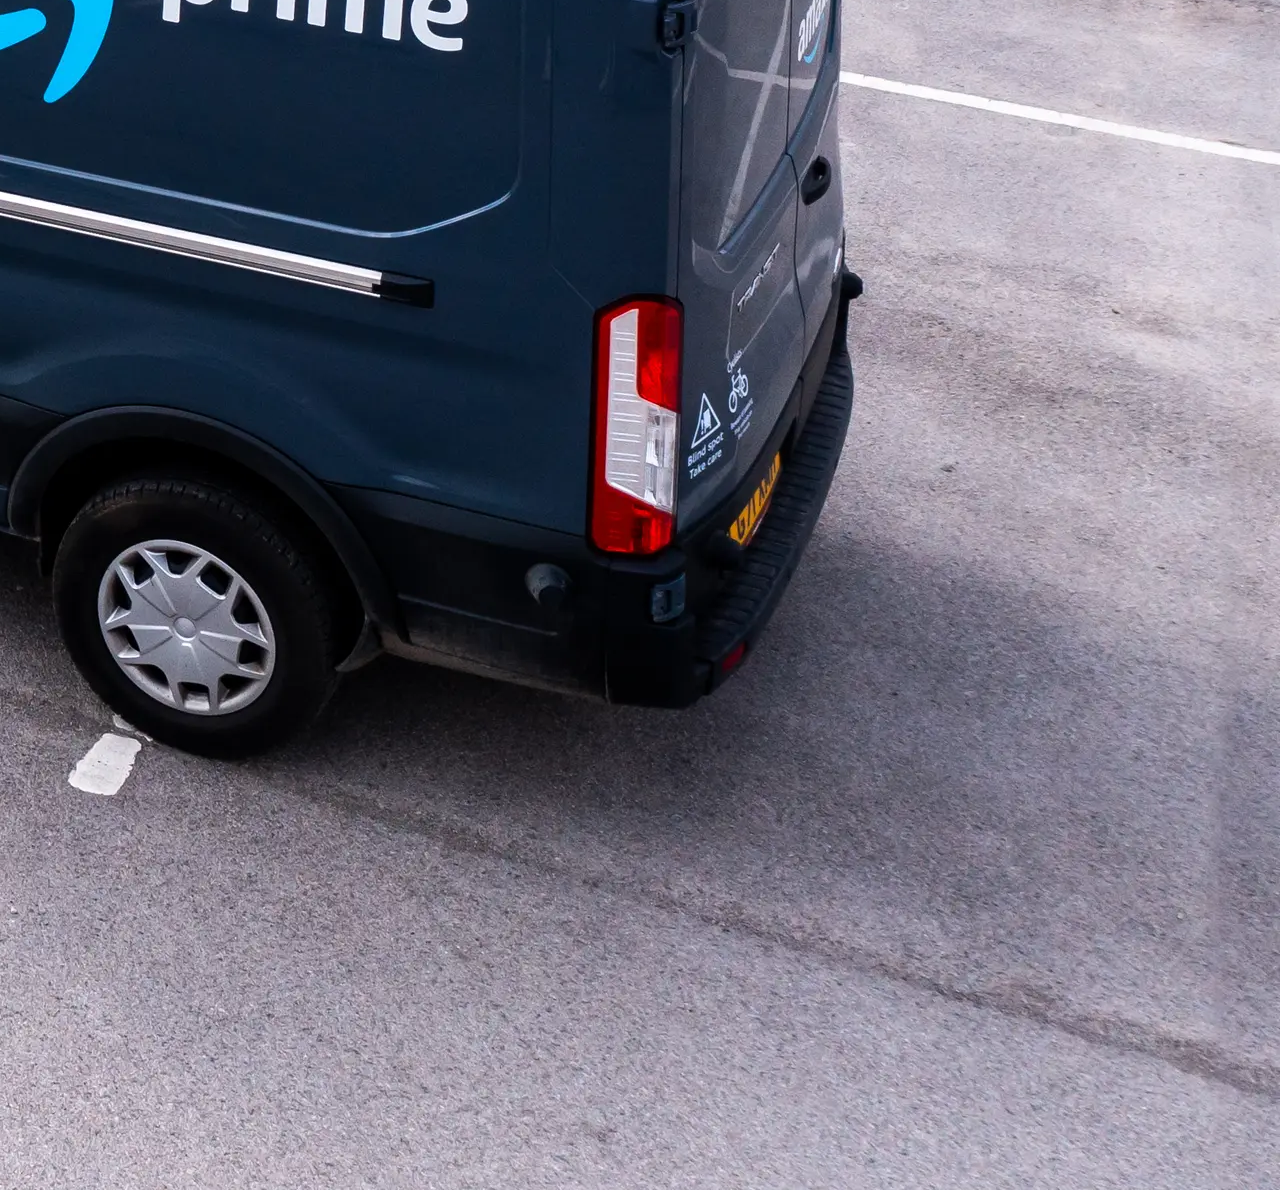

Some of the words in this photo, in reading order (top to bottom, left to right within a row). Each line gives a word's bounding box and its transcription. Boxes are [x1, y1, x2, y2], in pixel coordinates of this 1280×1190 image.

[687, 444, 706, 467] Blind
[707, 432, 725, 453] spot
[689, 461, 707, 480] Take
[707, 449, 723, 466] care
